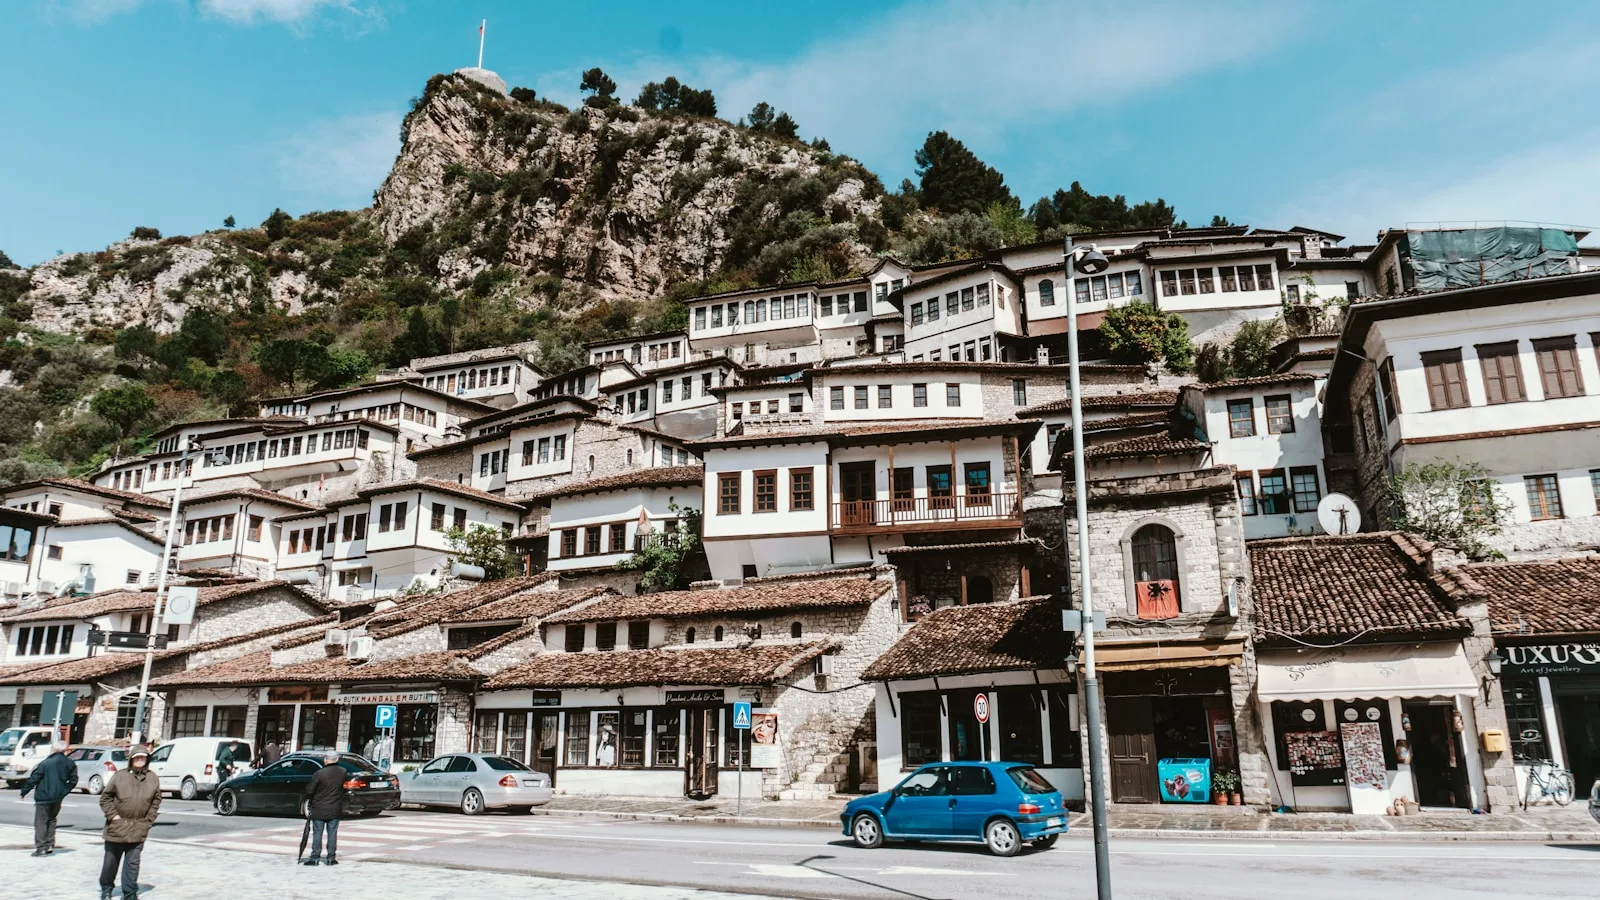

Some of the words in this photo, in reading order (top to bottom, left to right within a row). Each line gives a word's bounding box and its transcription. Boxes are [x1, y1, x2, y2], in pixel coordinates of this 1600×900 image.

[1536, 666, 1543, 674] of
[1544, 665, 1581, 673] Jewellery
[361, 694, 407, 702] MANGALEM
[703, 692, 711, 701] &
[978, 702, 986, 715] 30
[379, 707, 392, 726] P
